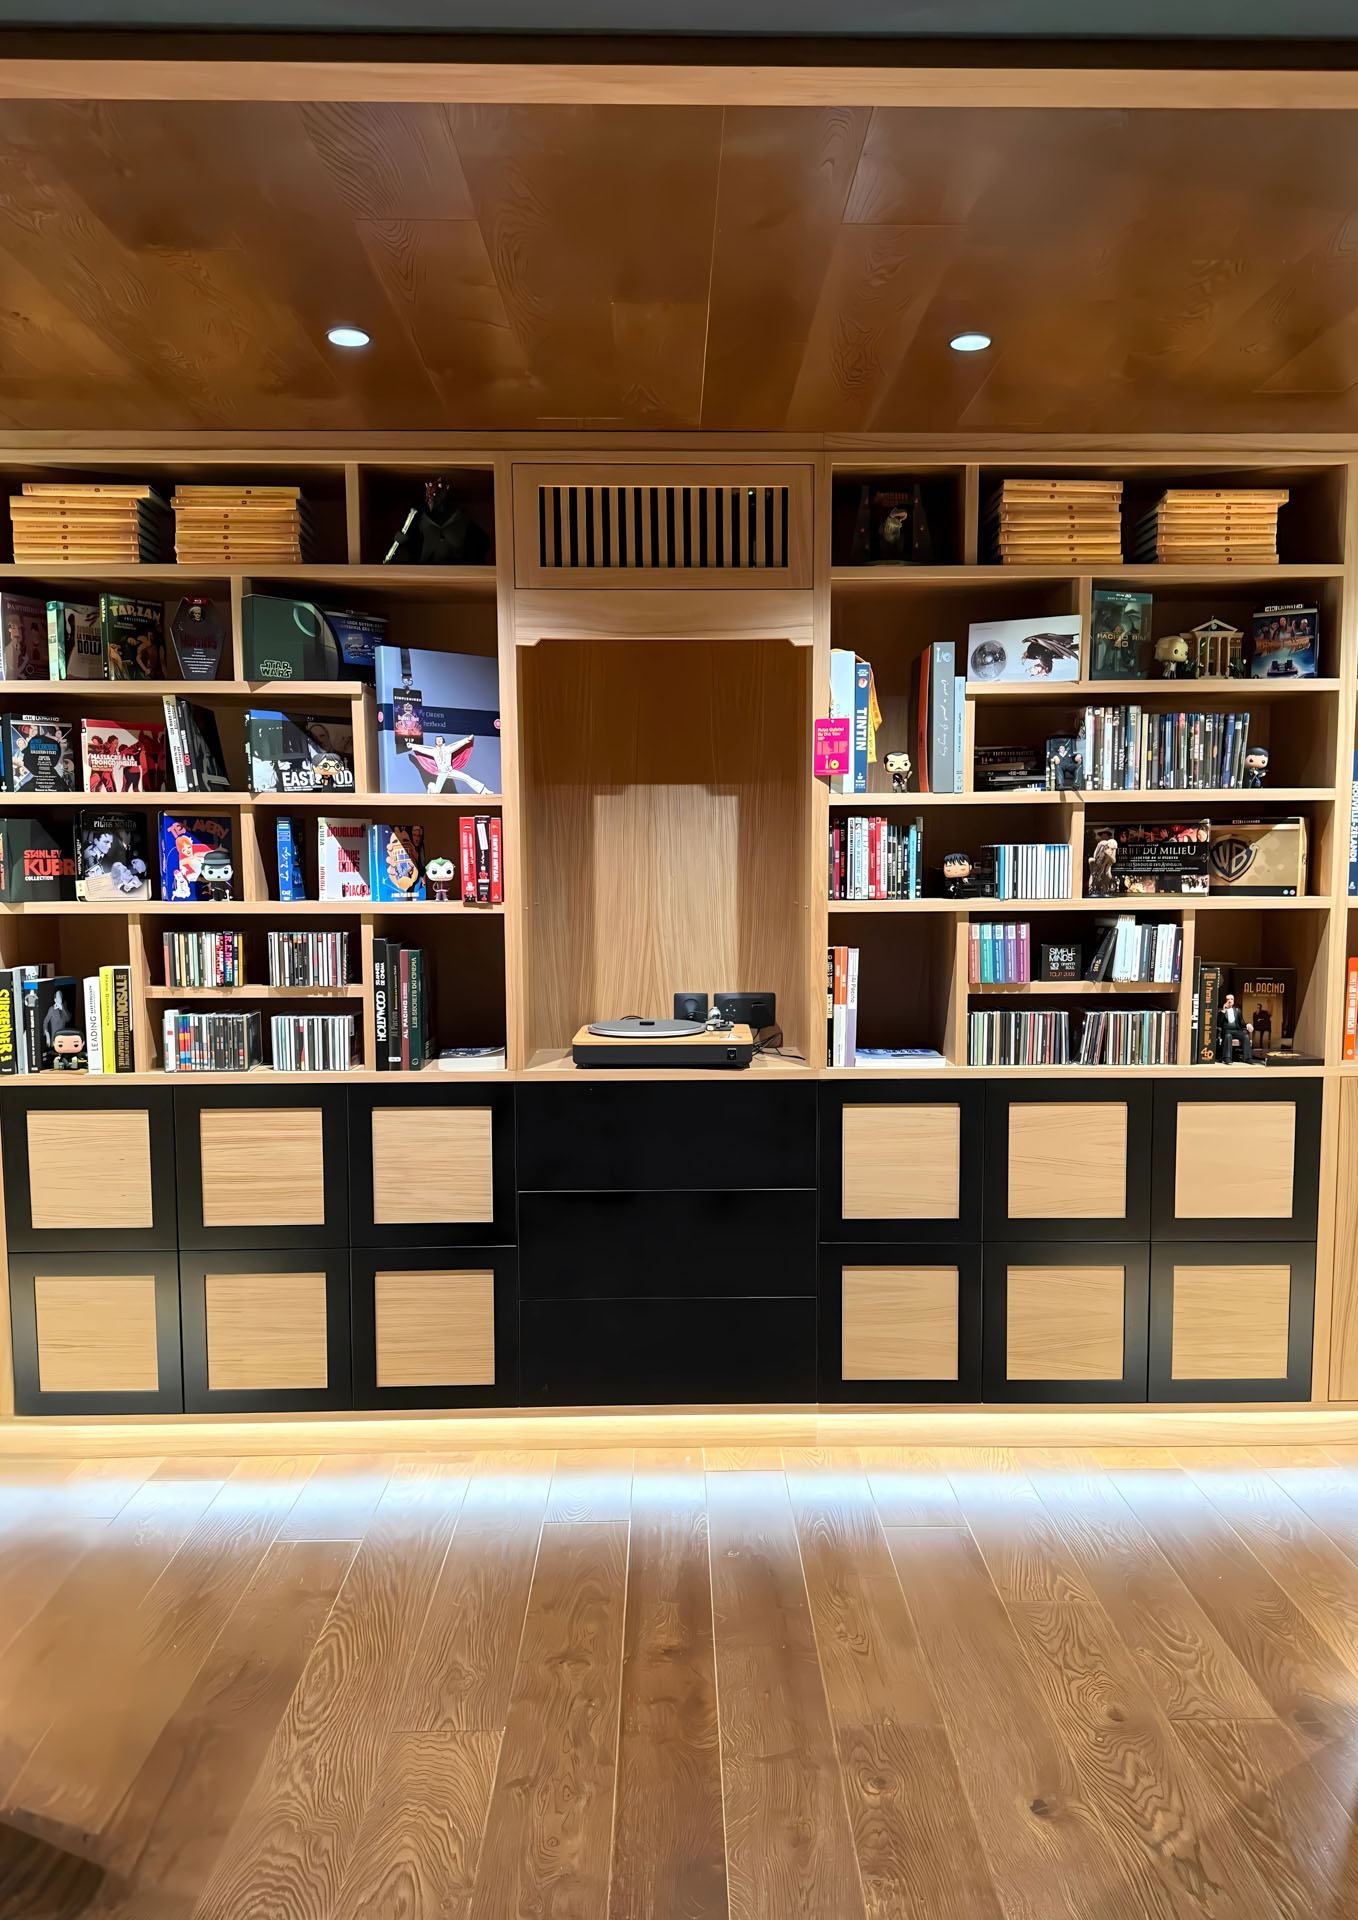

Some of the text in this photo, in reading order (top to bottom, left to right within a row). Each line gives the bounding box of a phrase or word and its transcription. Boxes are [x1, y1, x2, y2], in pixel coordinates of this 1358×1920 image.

[109, 604, 161, 620] TARZAN
[260, 660, 292, 669] STAR
[261, 668, 292, 678] WARS
[856, 707, 868, 751] TINTIN
[282, 770, 353, 787] EASTOD
[192, 820, 230, 839] AVERY
[24, 850, 62, 858] STANLEY
[1143, 847, 1157, 855] DU
[1160, 845, 1197, 855] MILIEU
[24, 859, 76, 876] KUBR
[1049, 947, 1076, 955] SIMPLE
[1049, 954, 1074, 962] MINDS
[411, 980, 418, 989] DU
[1244, 982, 1285, 994] AL PACINO
[116, 982, 128, 1017] TYSON
[0, 989, 13, 1054] SURRENDER
[376, 990, 387, 1042] HOLLYWOOD
[91, 1016, 99, 1052] LEADING
[403, 1029, 408, 1039] AL
